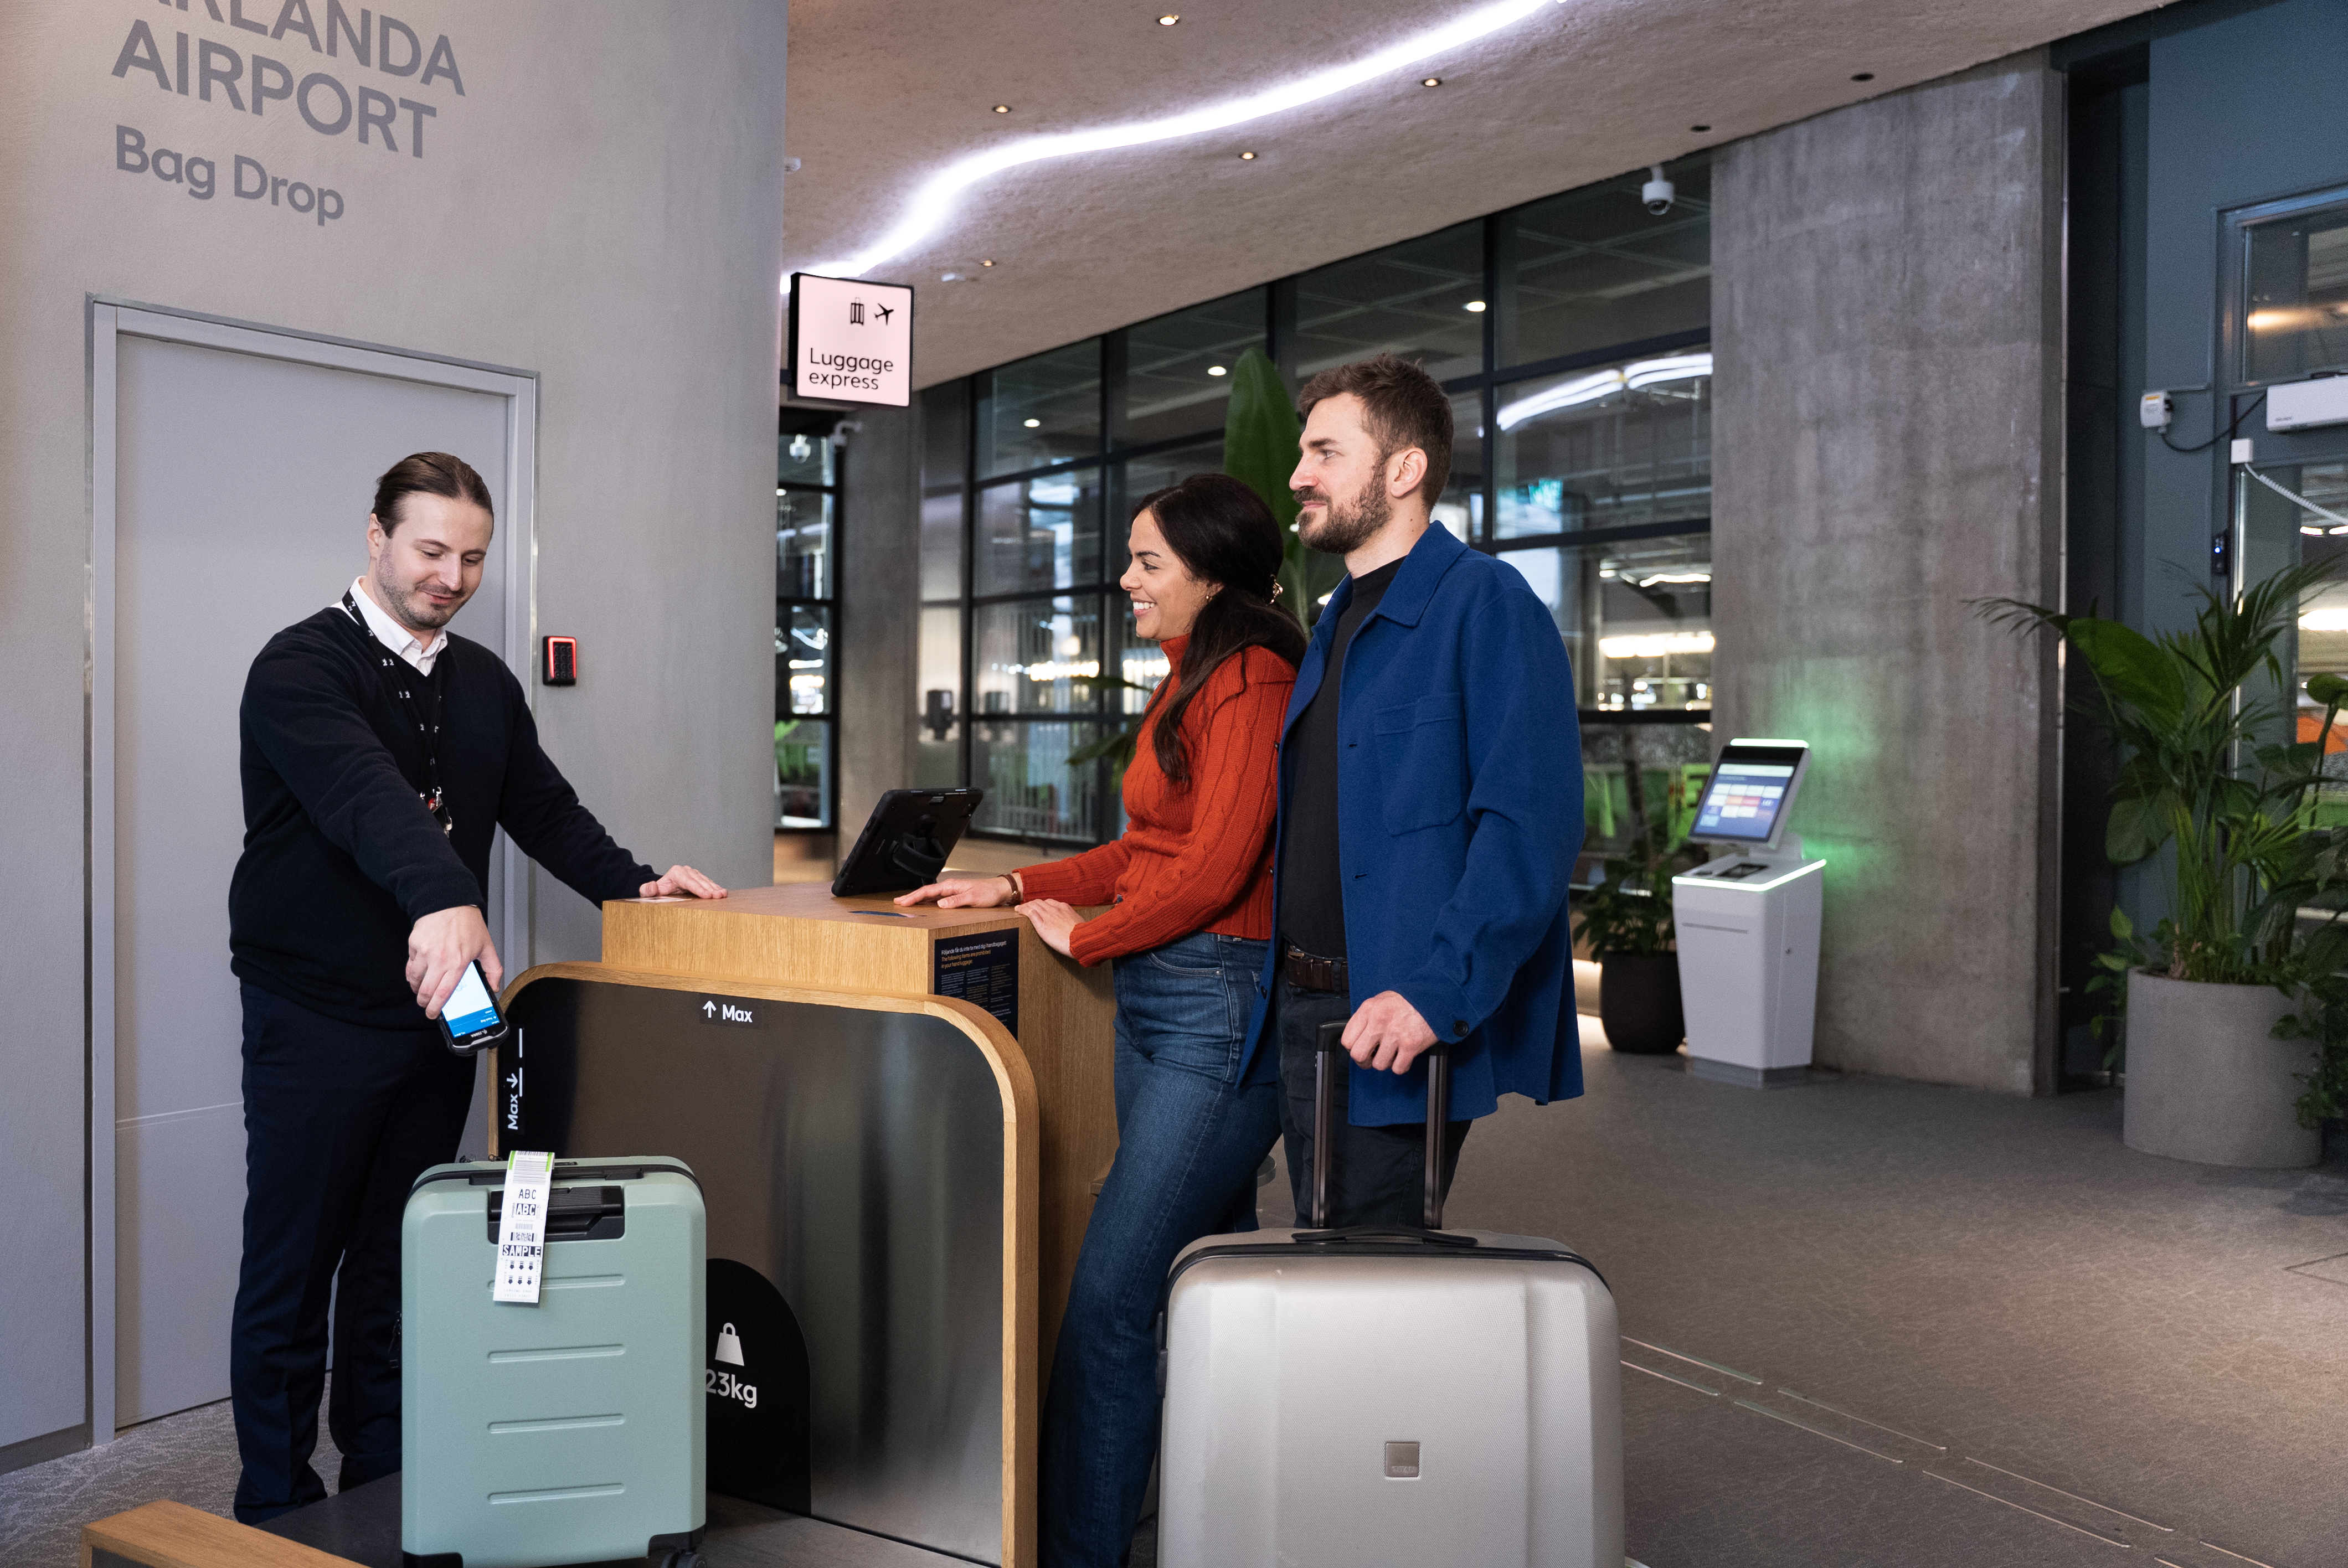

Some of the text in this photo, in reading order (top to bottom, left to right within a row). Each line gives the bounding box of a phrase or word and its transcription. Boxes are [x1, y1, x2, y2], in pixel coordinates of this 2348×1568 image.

[158, 0, 466, 96] LANDA
[111, 19, 437, 159] AIRPORT
[116, 125, 344, 226] Bag Drop
[810, 348, 893, 374] Luggage
[809, 372, 878, 389] express
[722, 1004, 753, 1023] Max
[508, 1094, 518, 1130] Max
[518, 1189, 537, 1199] ABC
[516, 1203, 535, 1215] ABC
[503, 1245, 541, 1257] SAMPLE
[706, 1369, 757, 1409] 23kg
